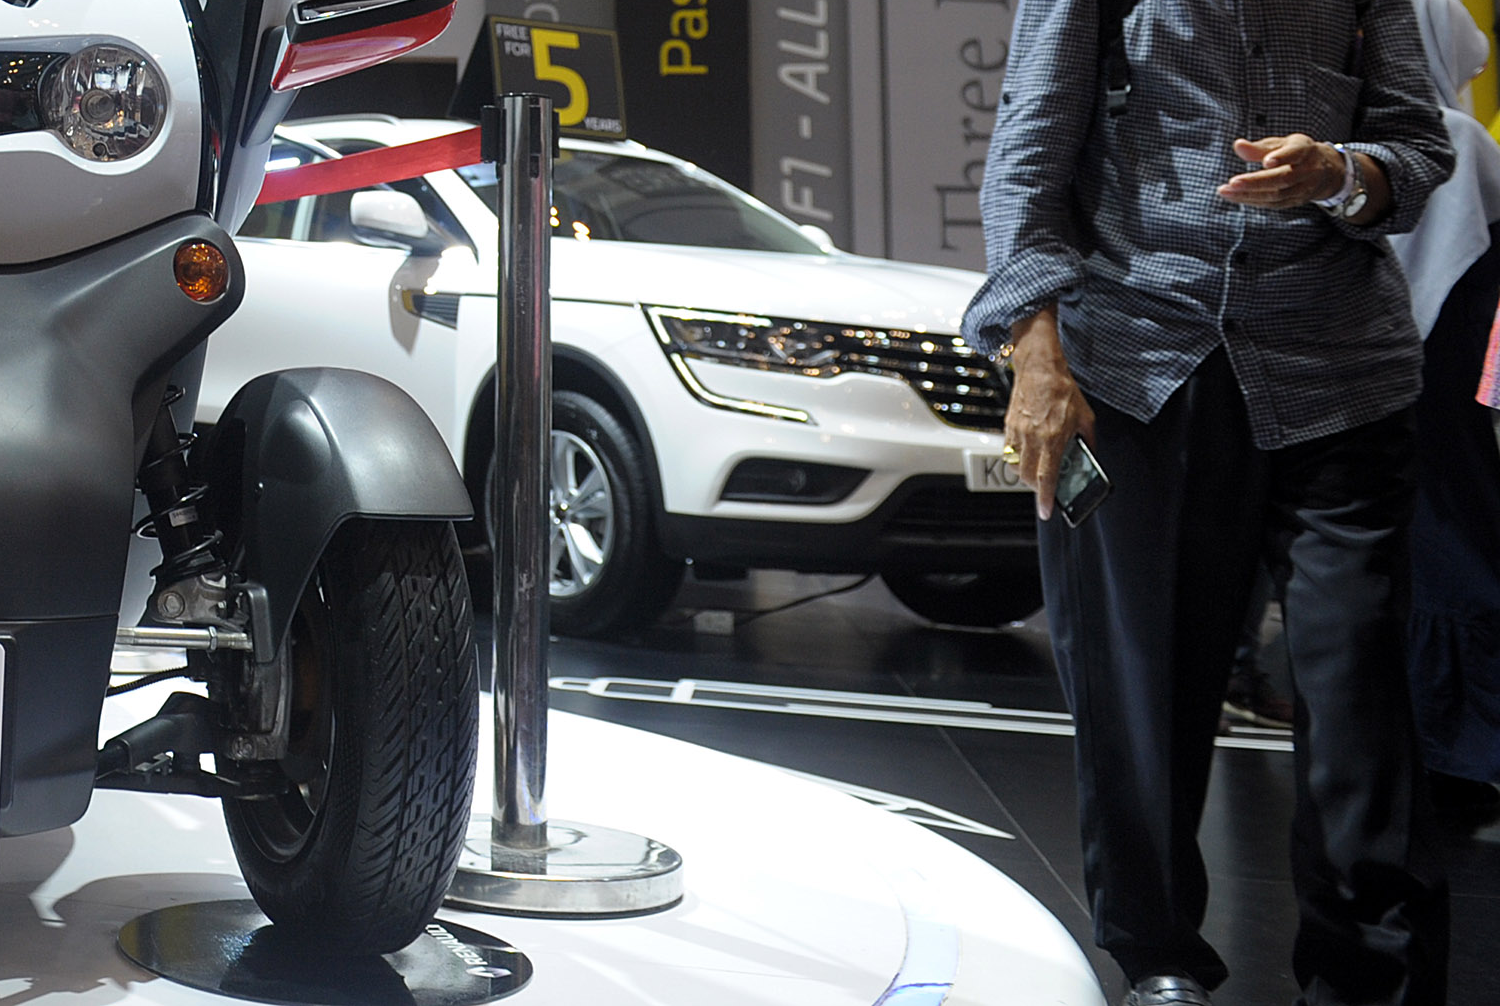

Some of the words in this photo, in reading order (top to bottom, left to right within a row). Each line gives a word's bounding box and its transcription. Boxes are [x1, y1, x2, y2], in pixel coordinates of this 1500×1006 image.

[495, 23, 529, 41] FREE
[504, 41, 533, 58] FOR
[530, 27, 590, 127] 5
[584, 116, 623, 133] YEARS
[780, 155, 834, 222] F1
